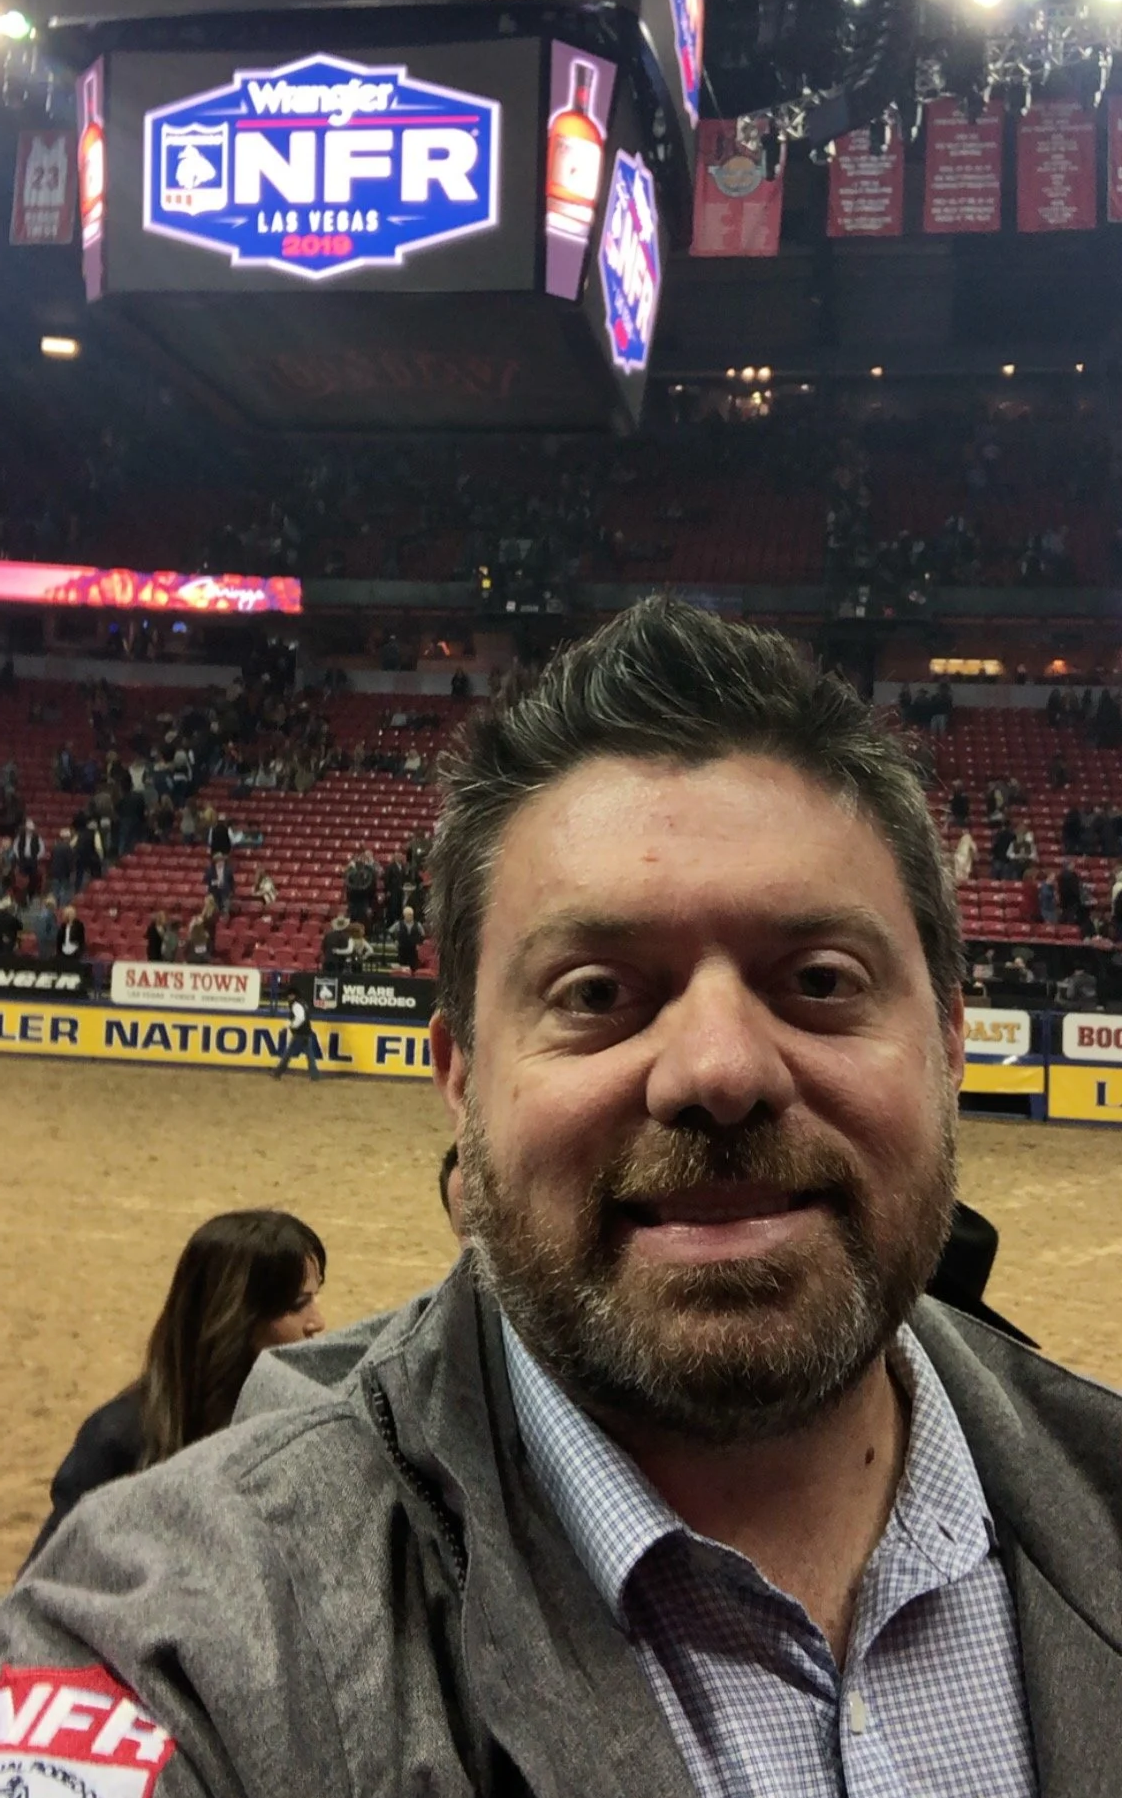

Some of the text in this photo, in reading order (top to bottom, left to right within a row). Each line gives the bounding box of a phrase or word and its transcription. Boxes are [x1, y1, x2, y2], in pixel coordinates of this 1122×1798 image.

[248, 79, 394, 126] Wrangler
[234, 129, 478, 204] NFR
[257, 209, 379, 233] LAS VEGAS
[282, 235, 352, 258] 2019
[126, 967, 249, 994] SAM'S TOWN
[343, 984, 395, 998] WE ARE
[342, 994, 416, 1009] PRORODEO
